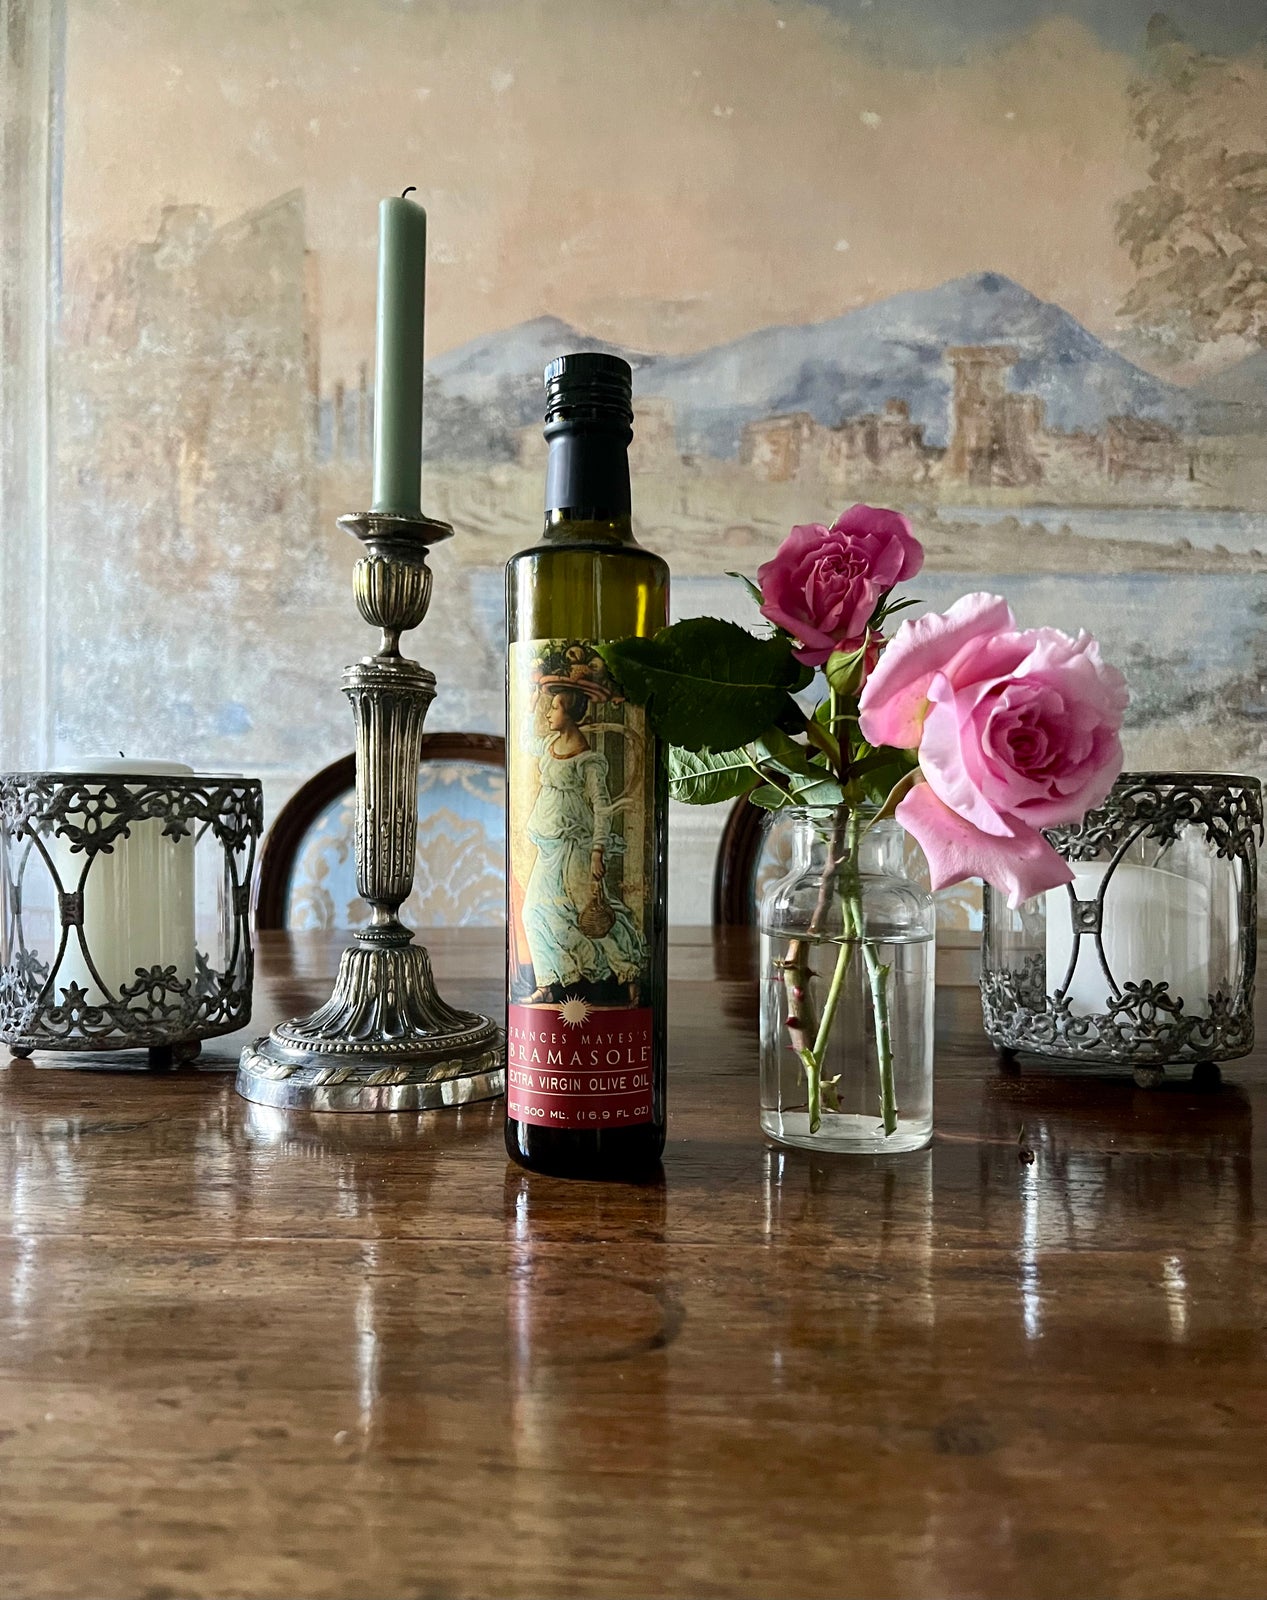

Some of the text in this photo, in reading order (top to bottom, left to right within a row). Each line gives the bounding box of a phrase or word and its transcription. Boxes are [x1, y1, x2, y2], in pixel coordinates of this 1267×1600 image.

[509, 1069, 649, 1091] EXTRA VIRGIN OLIVE OIL
[523, 1106, 545, 1117] 500
[576, 1110, 611, 1120] (16.9
[616, 1109, 630, 1118] FL
[633, 1106, 649, 1116] OZ)
